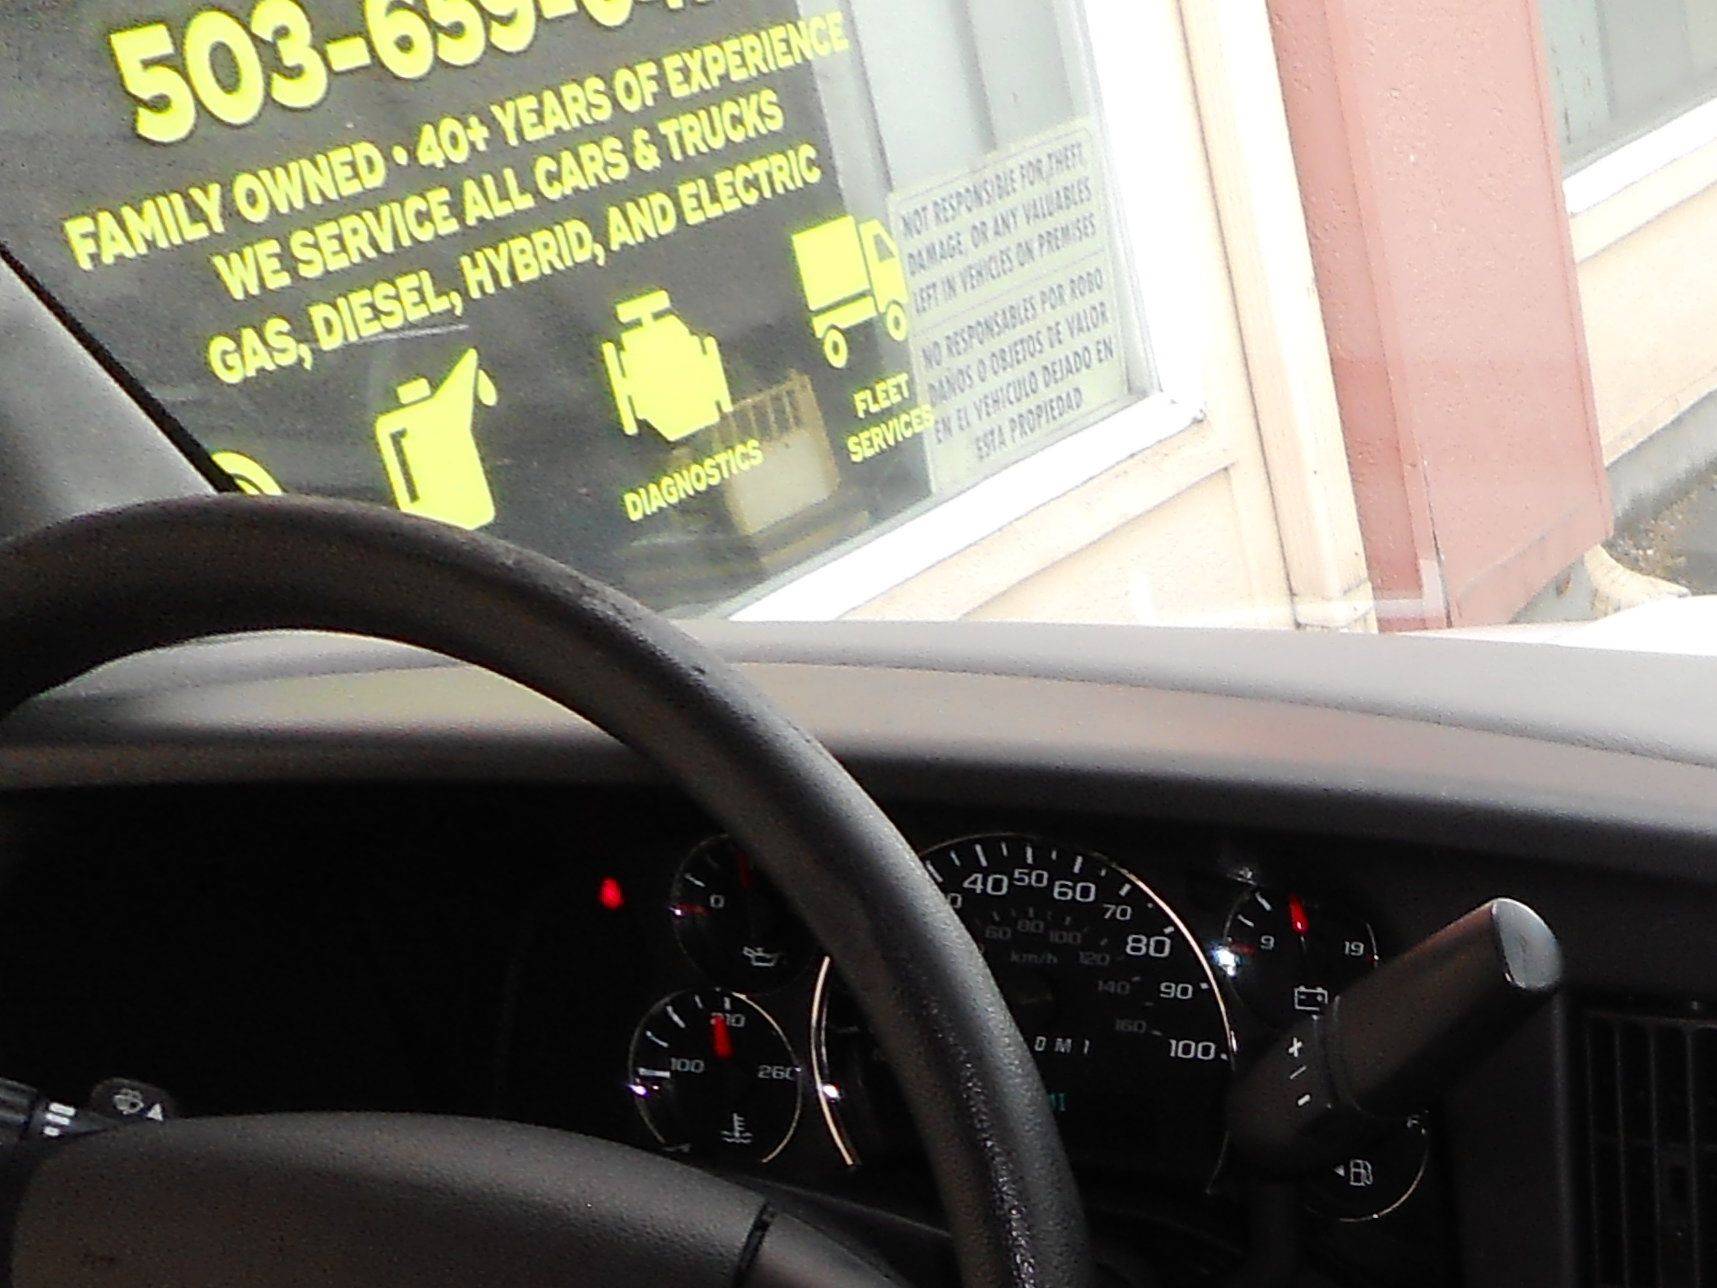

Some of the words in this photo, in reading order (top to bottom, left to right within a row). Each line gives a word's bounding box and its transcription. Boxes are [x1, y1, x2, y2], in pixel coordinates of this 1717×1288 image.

[65, 183, 224, 271] FAMILY
[233, 142, 386, 223] OWNED
[416, 115, 490, 168] 40+
[490, 76, 613, 146] YEARS
[613, 60, 660, 113] OF
[662, 11, 849, 98] EXPERIENCE
[211, 238, 291, 300] WE
[289, 187, 460, 279] SERVICE
[463, 168, 535, 227] ALL
[533, 136, 630, 200] CARS
[632, 128, 661, 172] &
[657, 89, 784, 161] TRUCKS
[902, 206, 928, 239] NOT
[932, 169, 1017, 226] RESPONSIBLE
[1020, 157, 1044, 190] FOR
[970, 220, 989, 249] OR
[993, 207, 1018, 237] ANY
[207, 316, 313, 384] GAS,
[308, 269, 463, 352] DIESEL,
[461, 219, 605, 299] HYBRID,
[607, 191, 677, 251] AND
[678, 143, 822, 226] ELECTRIC
[912, 281, 939, 315] LEFT
[941, 274, 957, 301] IN
[959, 247, 1014, 293] VEHICLES
[1016, 239, 1036, 268] ON
[1037, 212, 1097, 258] PREMISES
[922, 340, 943, 370] NO
[945, 296, 1038, 358] RESPONSABLES
[1039, 284, 1066, 313] POR
[1069, 268, 1104, 300] ROBO
[977, 358, 987, 383] O
[990, 330, 1044, 376] OBJETOS
[1047, 321, 1063, 349] DE
[1066, 301, 1109, 339] VALOR
[853, 372, 909, 419] FLEET
[934, 415, 953, 444] EN
[956, 407, 971, 432] EL
[1042, 346, 1092, 389] DEJADO
[1096, 336, 1115, 365] EN
[847, 404, 936, 463] SERVICES
[975, 425, 1008, 460] ESTA
[1009, 387, 1083, 443] PROPIEDAD
[623, 439, 763, 522] DIAGNOSTICS
[962, 872, 1009, 896] 40
[1013, 868, 1049, 887] 50
[709, 893, 725, 909] 0
[1053, 880, 1096, 903] 60
[1102, 903, 1132, 921] 70
[1125, 934, 1171, 958] 80
[1259, 935, 1275, 951] 9
[1344, 941, 1364, 957] 19
[1077, 950, 1110, 966] 120
[1098, 979, 1130, 995] 140
[1159, 981, 1193, 1000] 90
[1115, 1017, 1147, 1033] 160
[1168, 1039, 1216, 1061] 100
[670, 1057, 705, 1074] 100
[757, 1064, 797, 1081] 260
